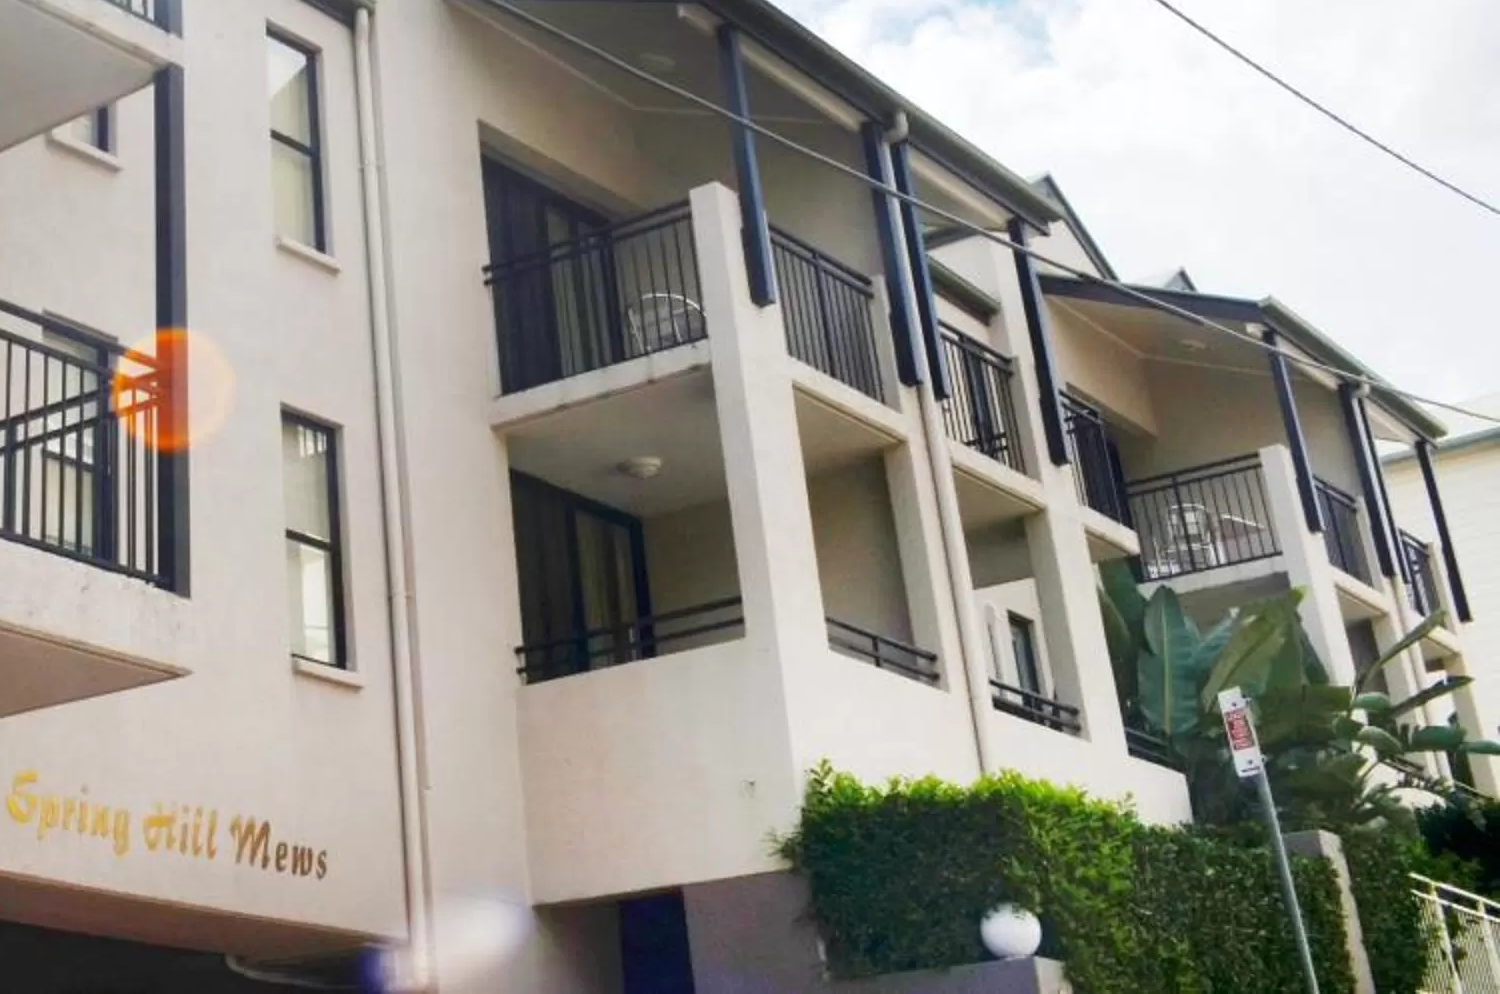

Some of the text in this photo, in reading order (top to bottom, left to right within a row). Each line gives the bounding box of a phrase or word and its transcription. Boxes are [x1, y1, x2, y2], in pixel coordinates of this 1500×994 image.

[5, 769, 328, 881] Spring Hill Mews
